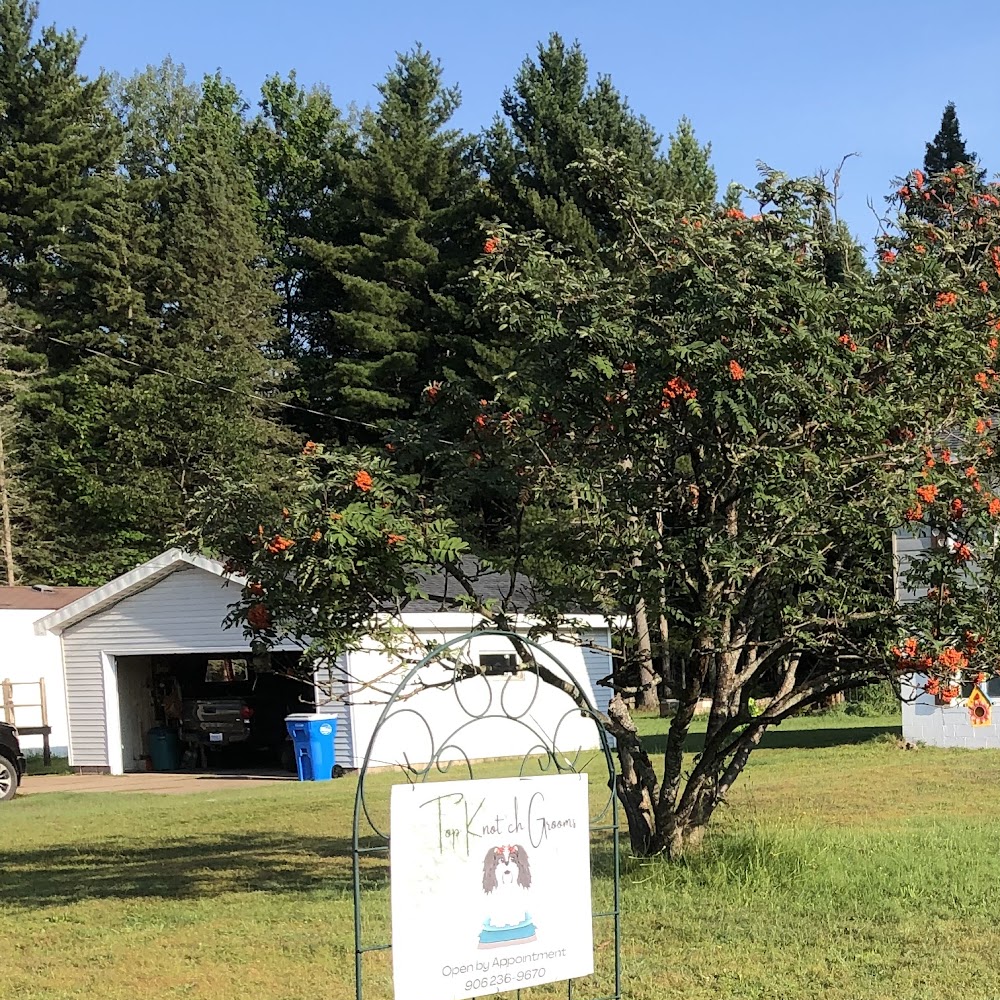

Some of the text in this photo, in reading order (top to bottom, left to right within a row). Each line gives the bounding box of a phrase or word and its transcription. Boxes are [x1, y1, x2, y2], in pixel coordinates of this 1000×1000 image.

[419, 792, 464, 854] Top
[528, 792, 577, 848] Grooms
[442, 948, 566, 978] Open by Appointment
[464, 967, 546, 991] 906 236-9670
